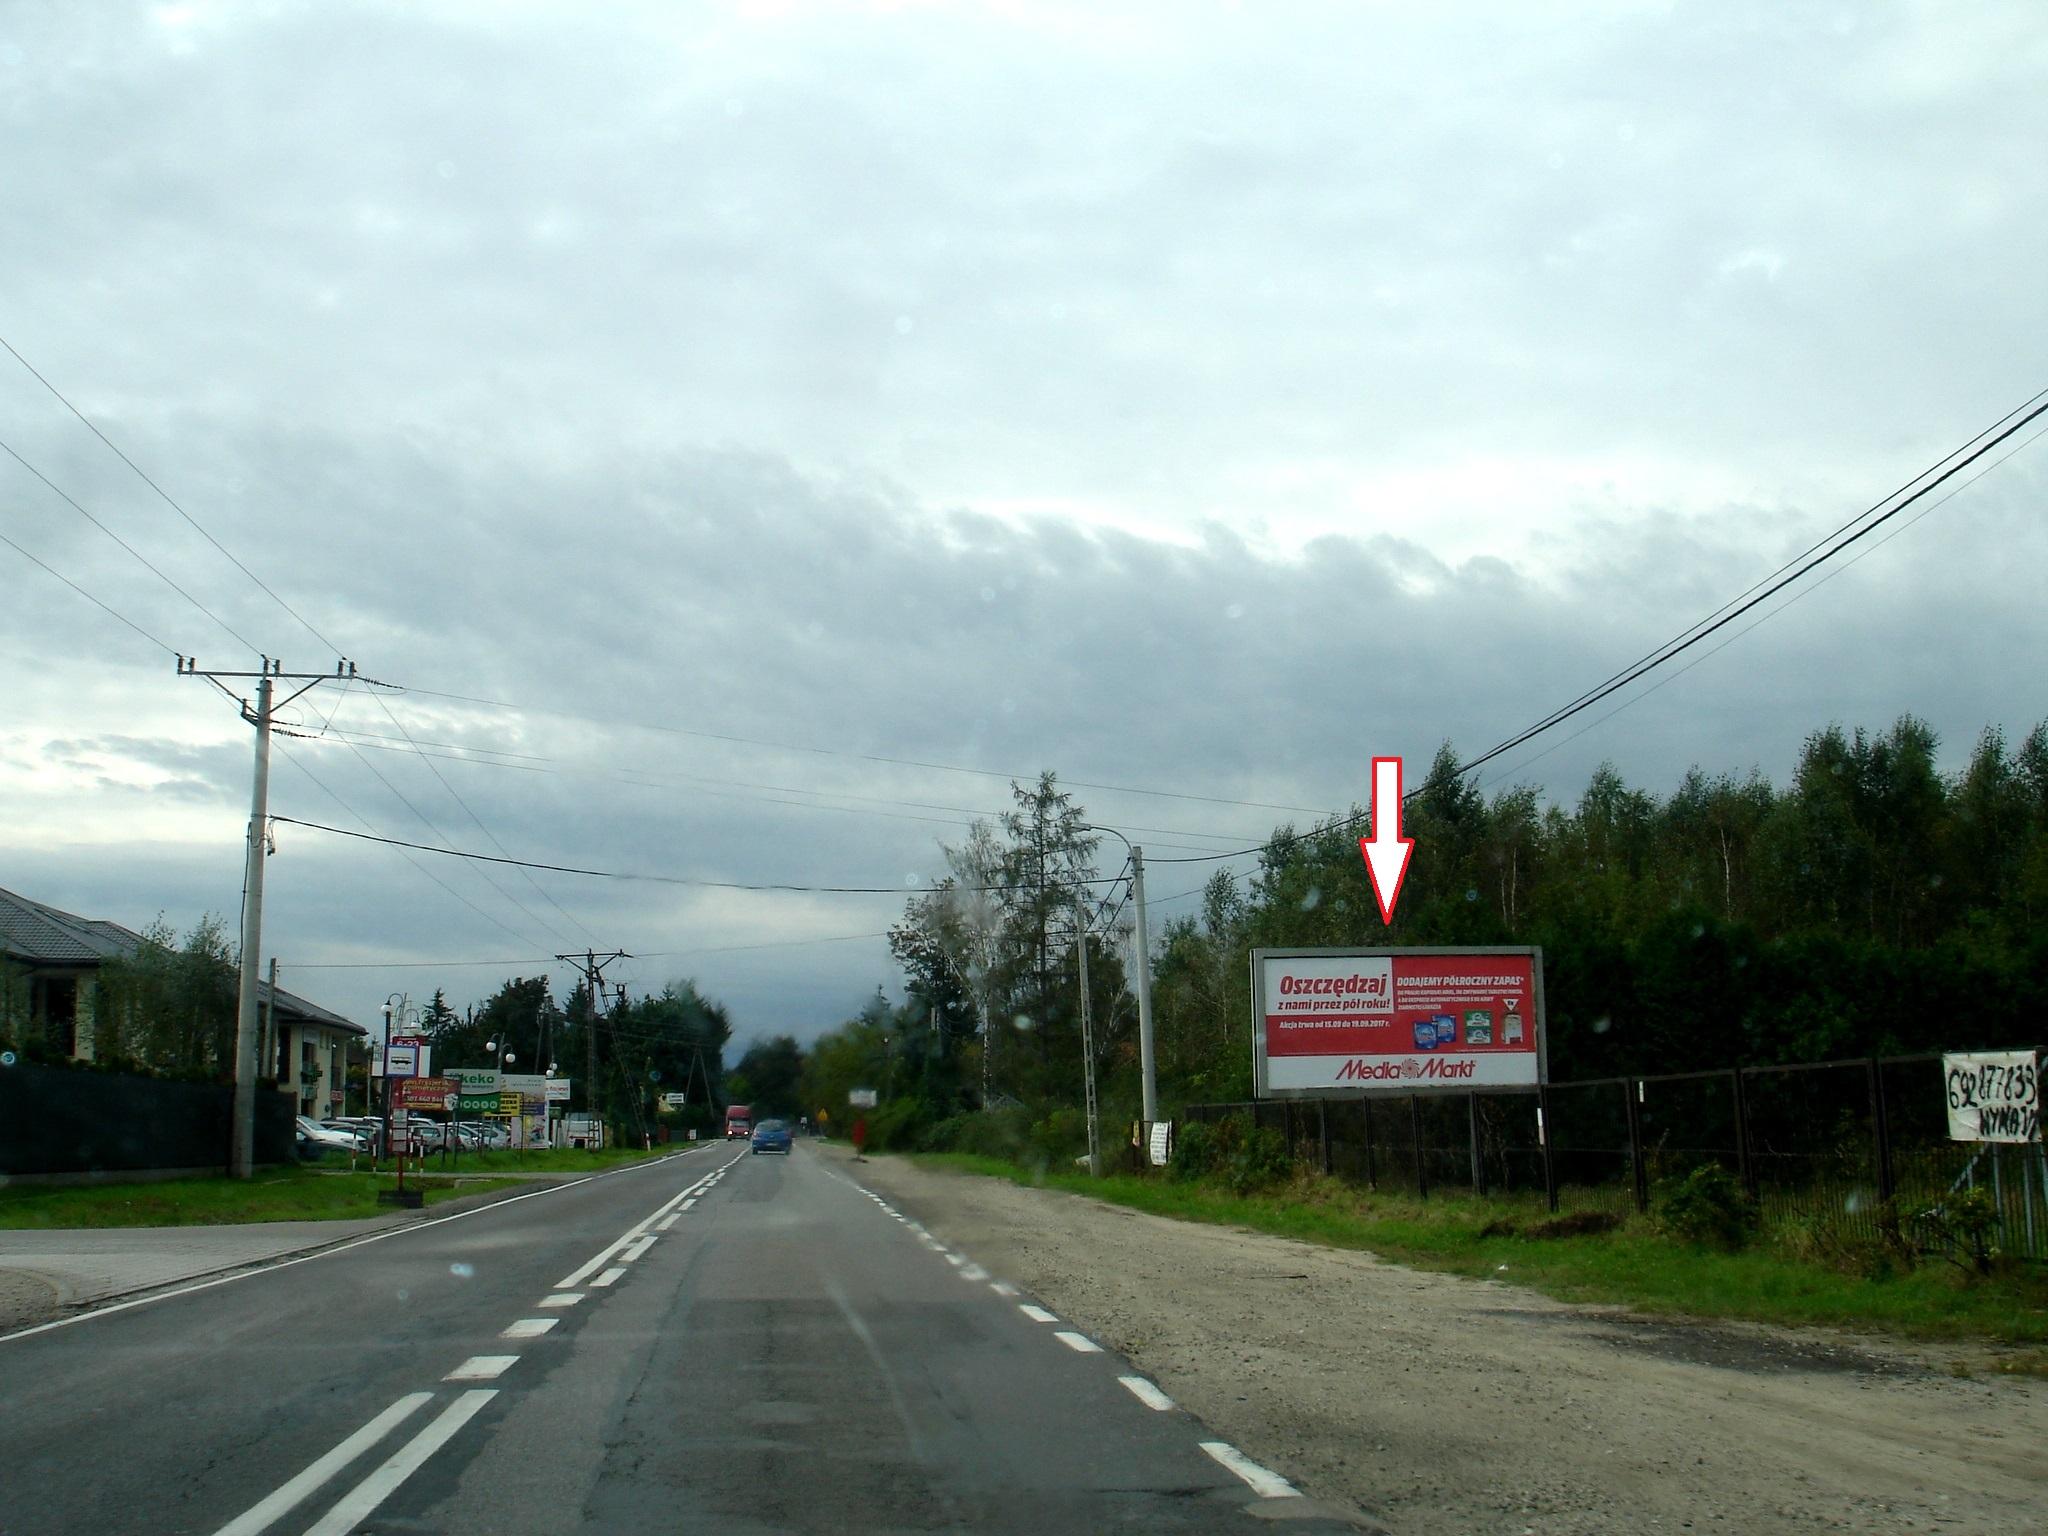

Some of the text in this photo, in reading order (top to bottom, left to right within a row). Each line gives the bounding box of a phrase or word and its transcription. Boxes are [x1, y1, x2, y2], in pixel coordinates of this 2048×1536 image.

[1280, 973, 1387, 998] Oszczędzaj
[1397, 976, 1443, 987] DODAJEMY
[1443, 975, 1494, 986] PÓŁROCZNY
[1278, 1002, 1283, 1010] z
[1285, 999, 1312, 1010] nami
[1313, 1001, 1341, 1011] przez
[1343, 998, 1361, 1011] pół
[1362, 998, 1391, 1009] roku!
[1279, 1021, 1297, 1029] Akcja
[1315, 1020, 1323, 1028] od
[1342, 1020, 1351, 1028] do
[1335, 1058, 1475, 1080] Media Markt
